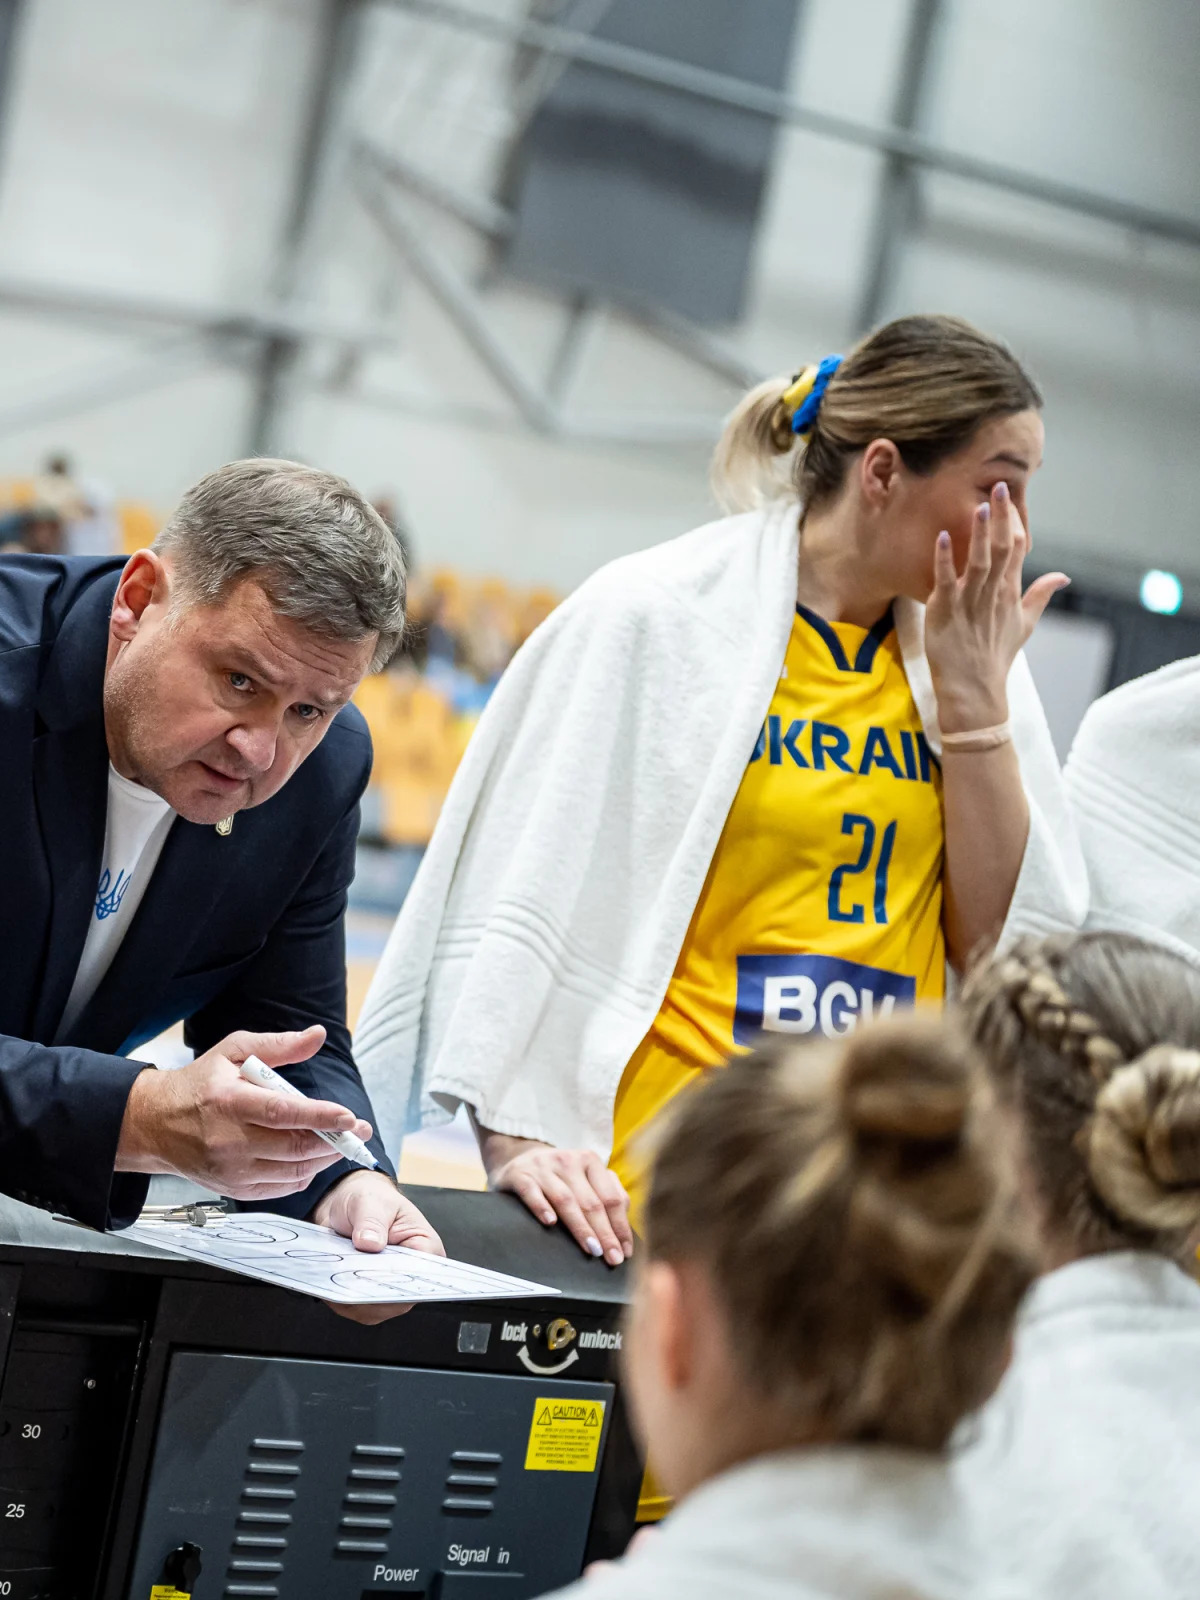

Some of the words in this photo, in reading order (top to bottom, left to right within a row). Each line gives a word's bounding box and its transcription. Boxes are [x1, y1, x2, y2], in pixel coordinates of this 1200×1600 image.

[828, 813, 898, 924] 21
[500, 1321, 528, 1342] lock
[578, 1329, 622, 1349] unlock
[552, 1406, 587, 1418] CAUTION
[21, 1424, 41, 1439] 30
[5, 1503, 25, 1518] 25
[447, 1544, 490, 1566] Signal
[497, 1548, 510, 1564] in
[373, 1565, 419, 1581] Power
